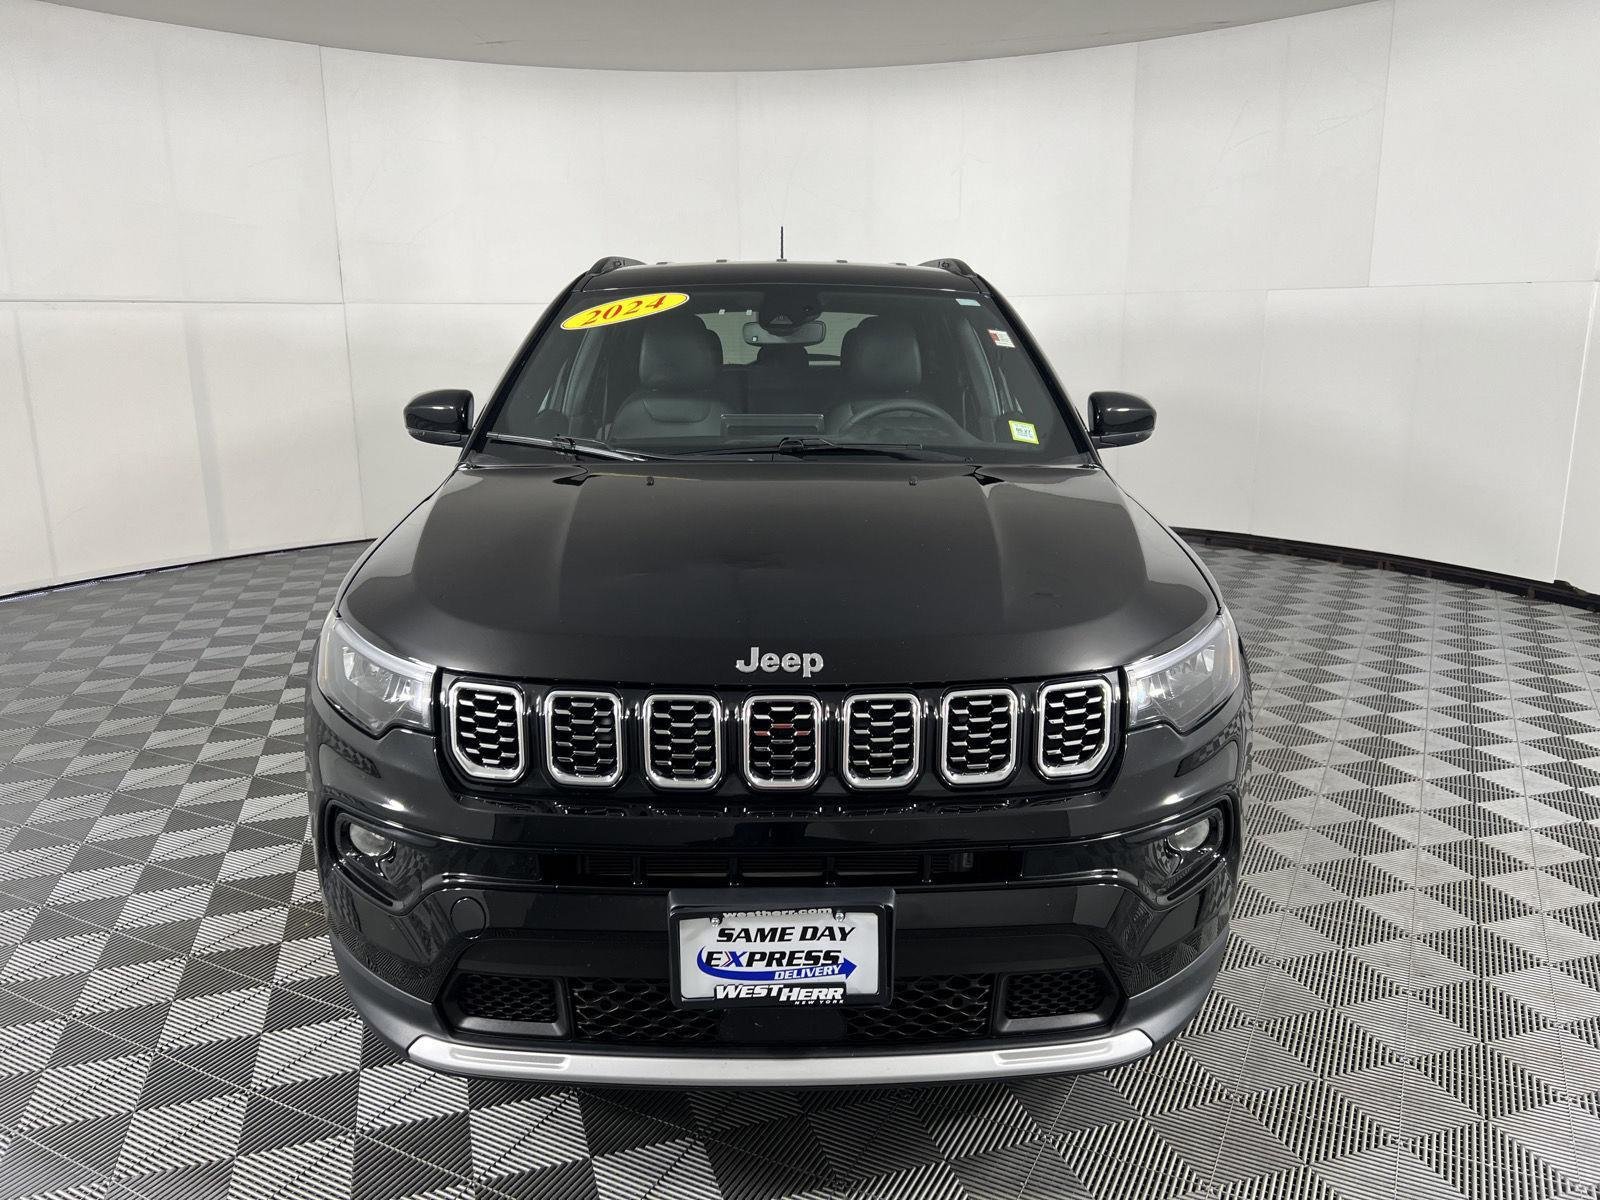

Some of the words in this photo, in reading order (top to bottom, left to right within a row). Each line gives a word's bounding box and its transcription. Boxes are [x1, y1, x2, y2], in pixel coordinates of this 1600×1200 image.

[580, 296, 667, 326] 2024
[736, 646, 823, 678] Jeep
[716, 926, 796, 943] SAME
[799, 926, 856, 942] DAY
[704, 950, 842, 968] EXPRESS
[773, 964, 843, 980] DELIVERY
